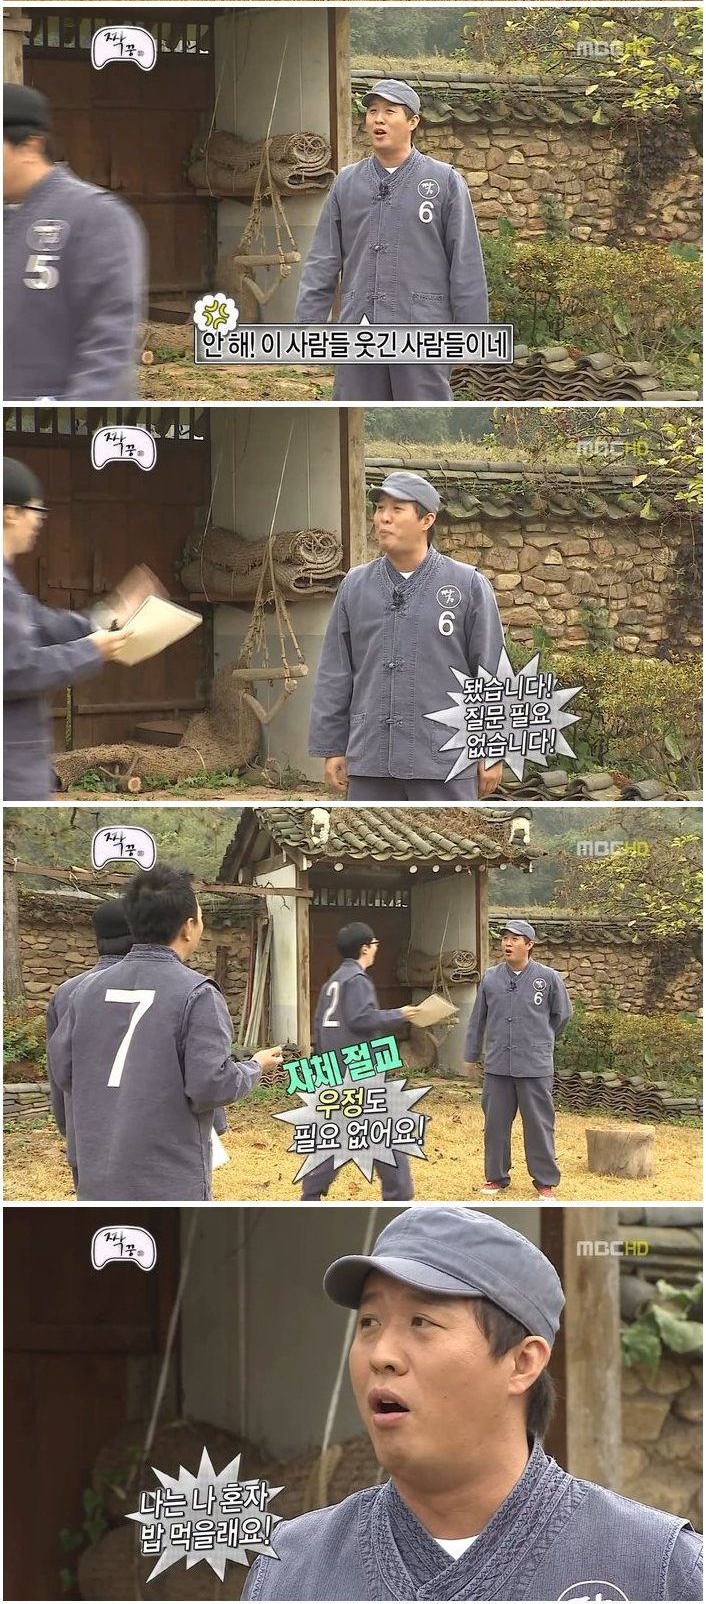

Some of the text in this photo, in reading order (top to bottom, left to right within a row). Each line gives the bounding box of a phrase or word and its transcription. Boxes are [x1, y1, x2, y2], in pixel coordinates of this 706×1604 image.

[418, 201, 435, 224] 6
[23, 254, 60, 290] 5
[438, 611, 455, 636] 6
[321, 981, 341, 1028] 2
[533, 991, 544, 1005] 6
[104, 988, 155, 1088] 7
